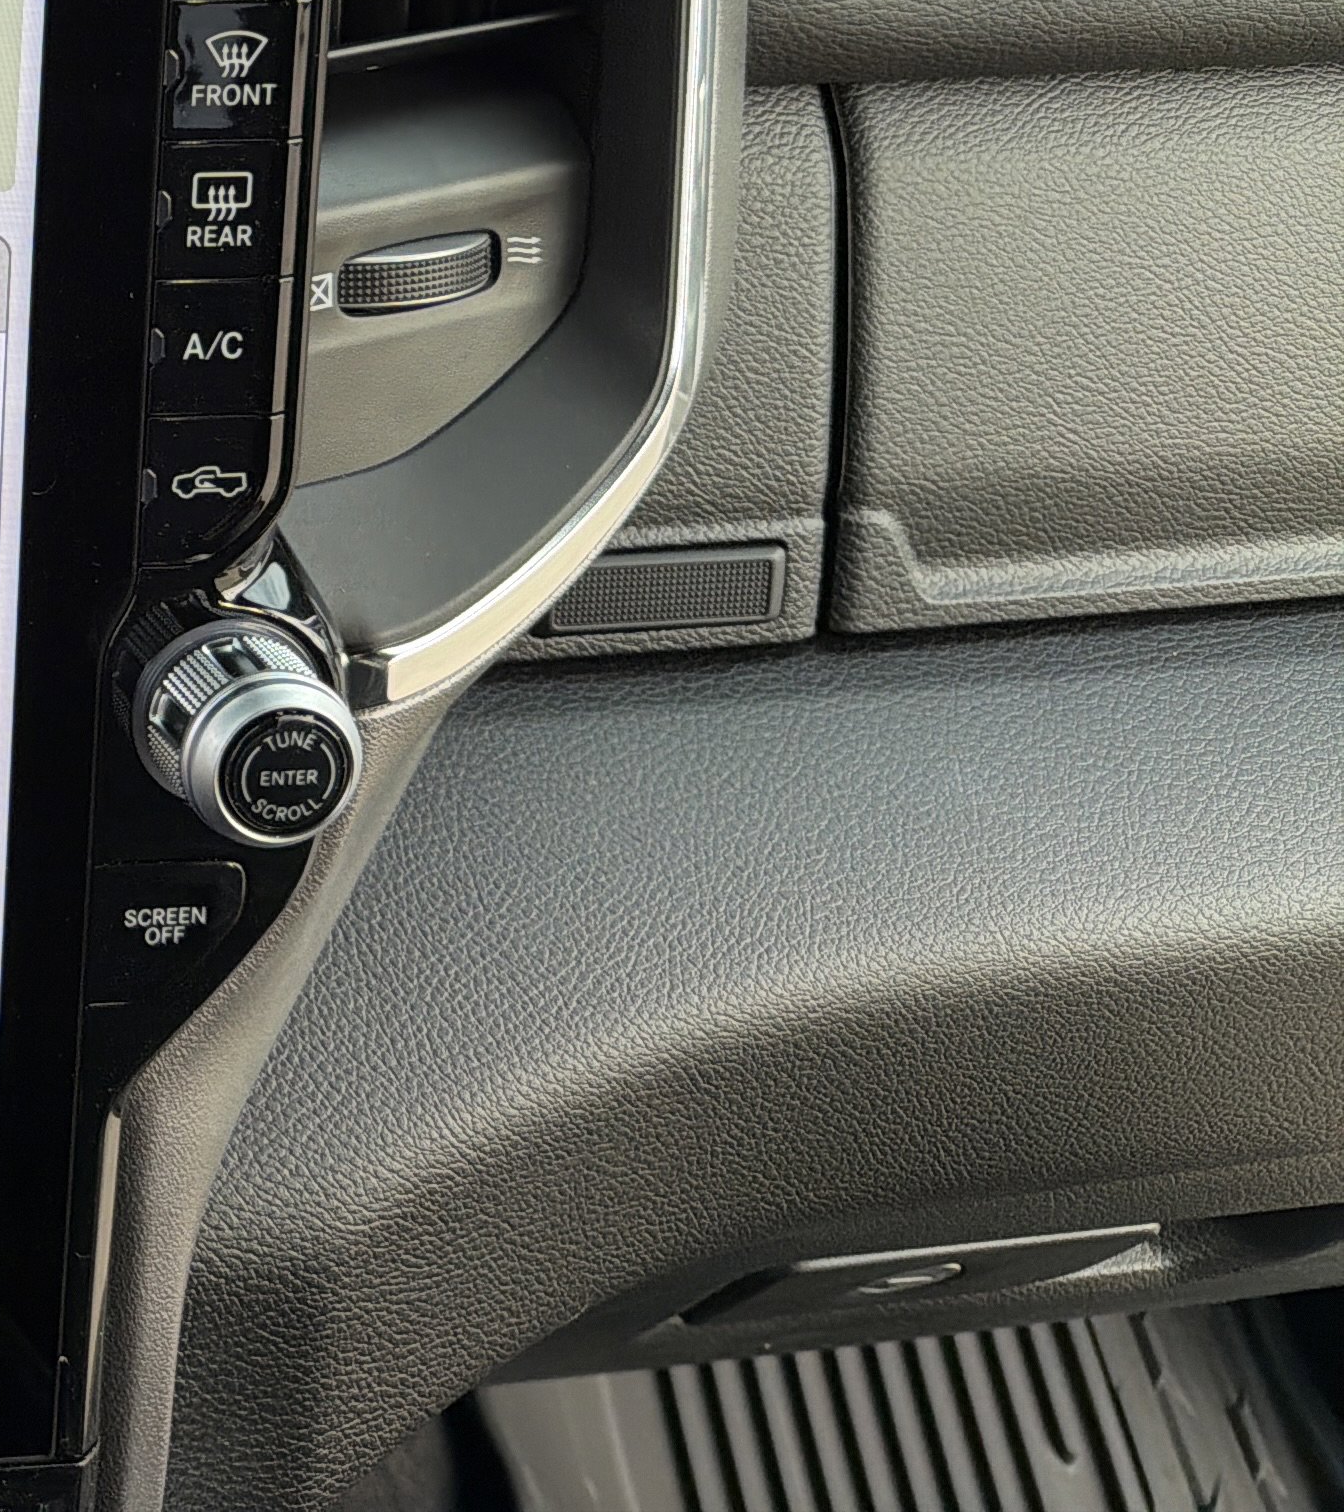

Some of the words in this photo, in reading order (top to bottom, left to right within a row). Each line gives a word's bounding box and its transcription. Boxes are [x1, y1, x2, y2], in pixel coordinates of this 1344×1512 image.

[190, 83, 277, 107] FRONT
[186, 224, 253, 248] REAR
[182, 330, 243, 361] A/C
[263, 730, 319, 753] TUNE
[259, 768, 319, 787] ENTER
[250, 797, 325, 823] SCROLL
[123, 906, 208, 929] SCREEN
[144, 925, 187, 947] OFF
